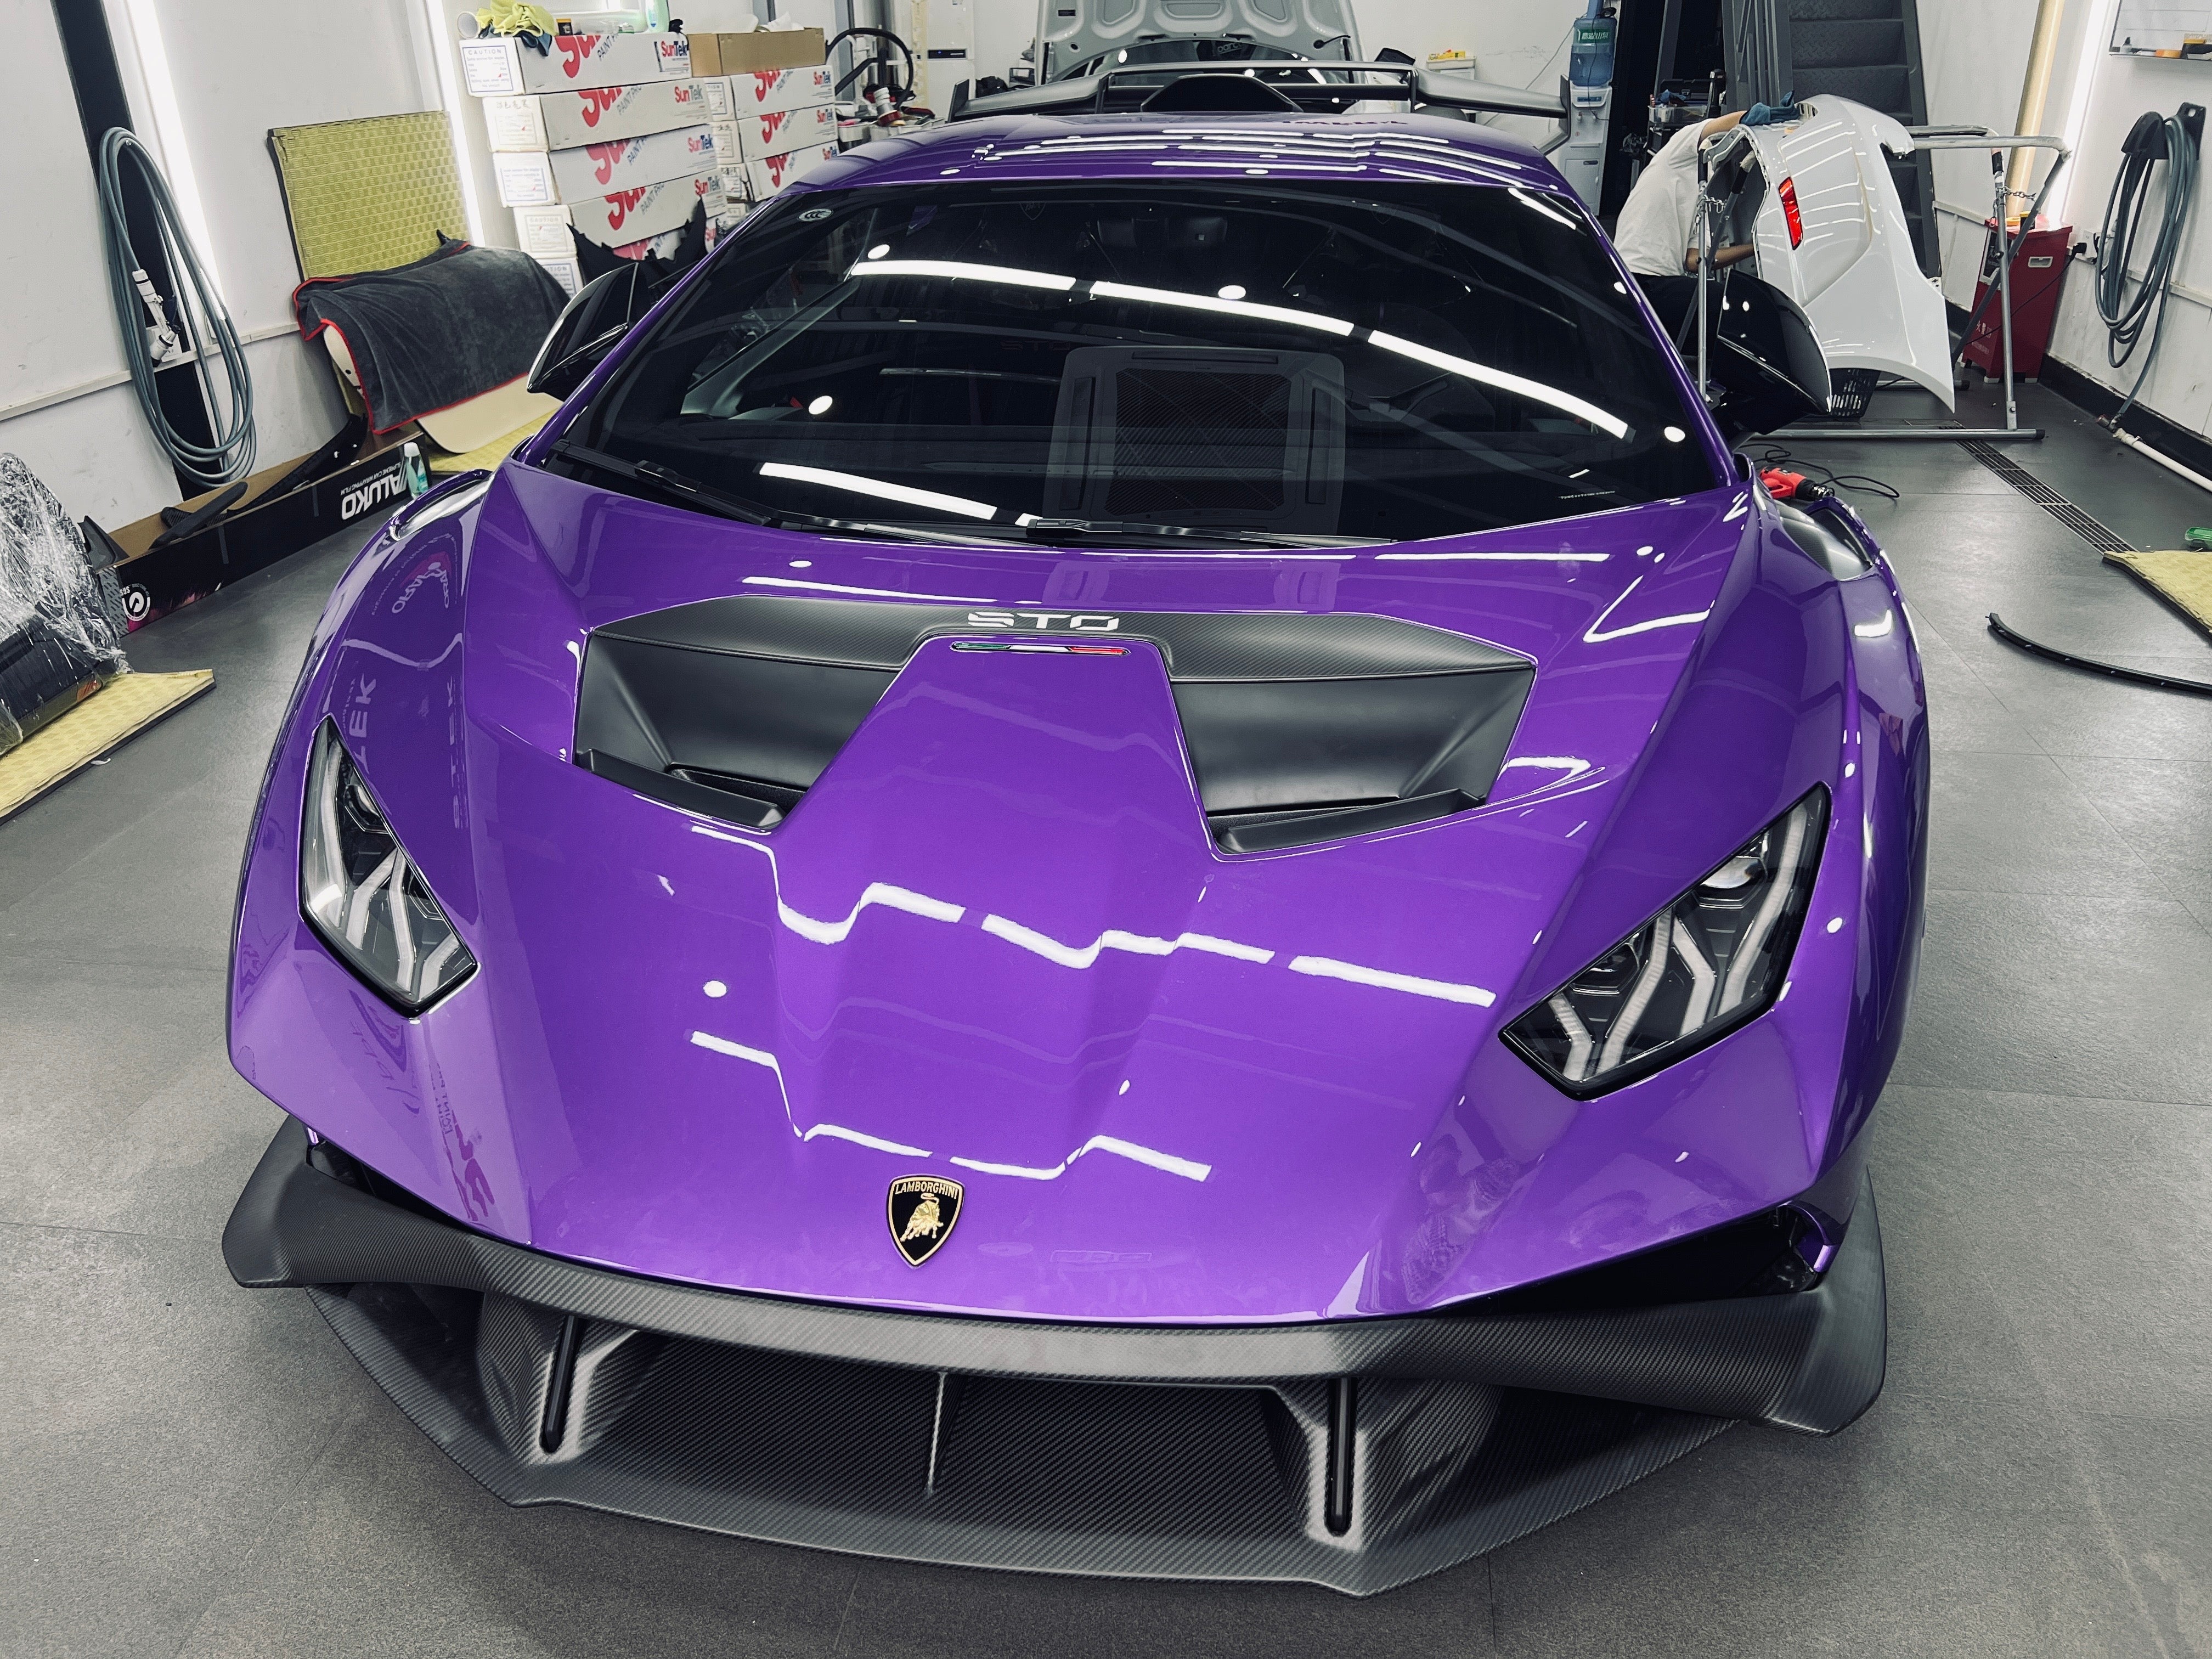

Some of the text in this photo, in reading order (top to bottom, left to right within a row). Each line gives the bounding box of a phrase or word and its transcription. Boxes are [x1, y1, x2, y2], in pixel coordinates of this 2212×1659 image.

[661, 41, 689, 58] SunTek
[674, 84, 703, 103] SunTek
[968, 612, 1119, 631] STO
[895, 1181, 959, 1200] LAMBORGHINI
